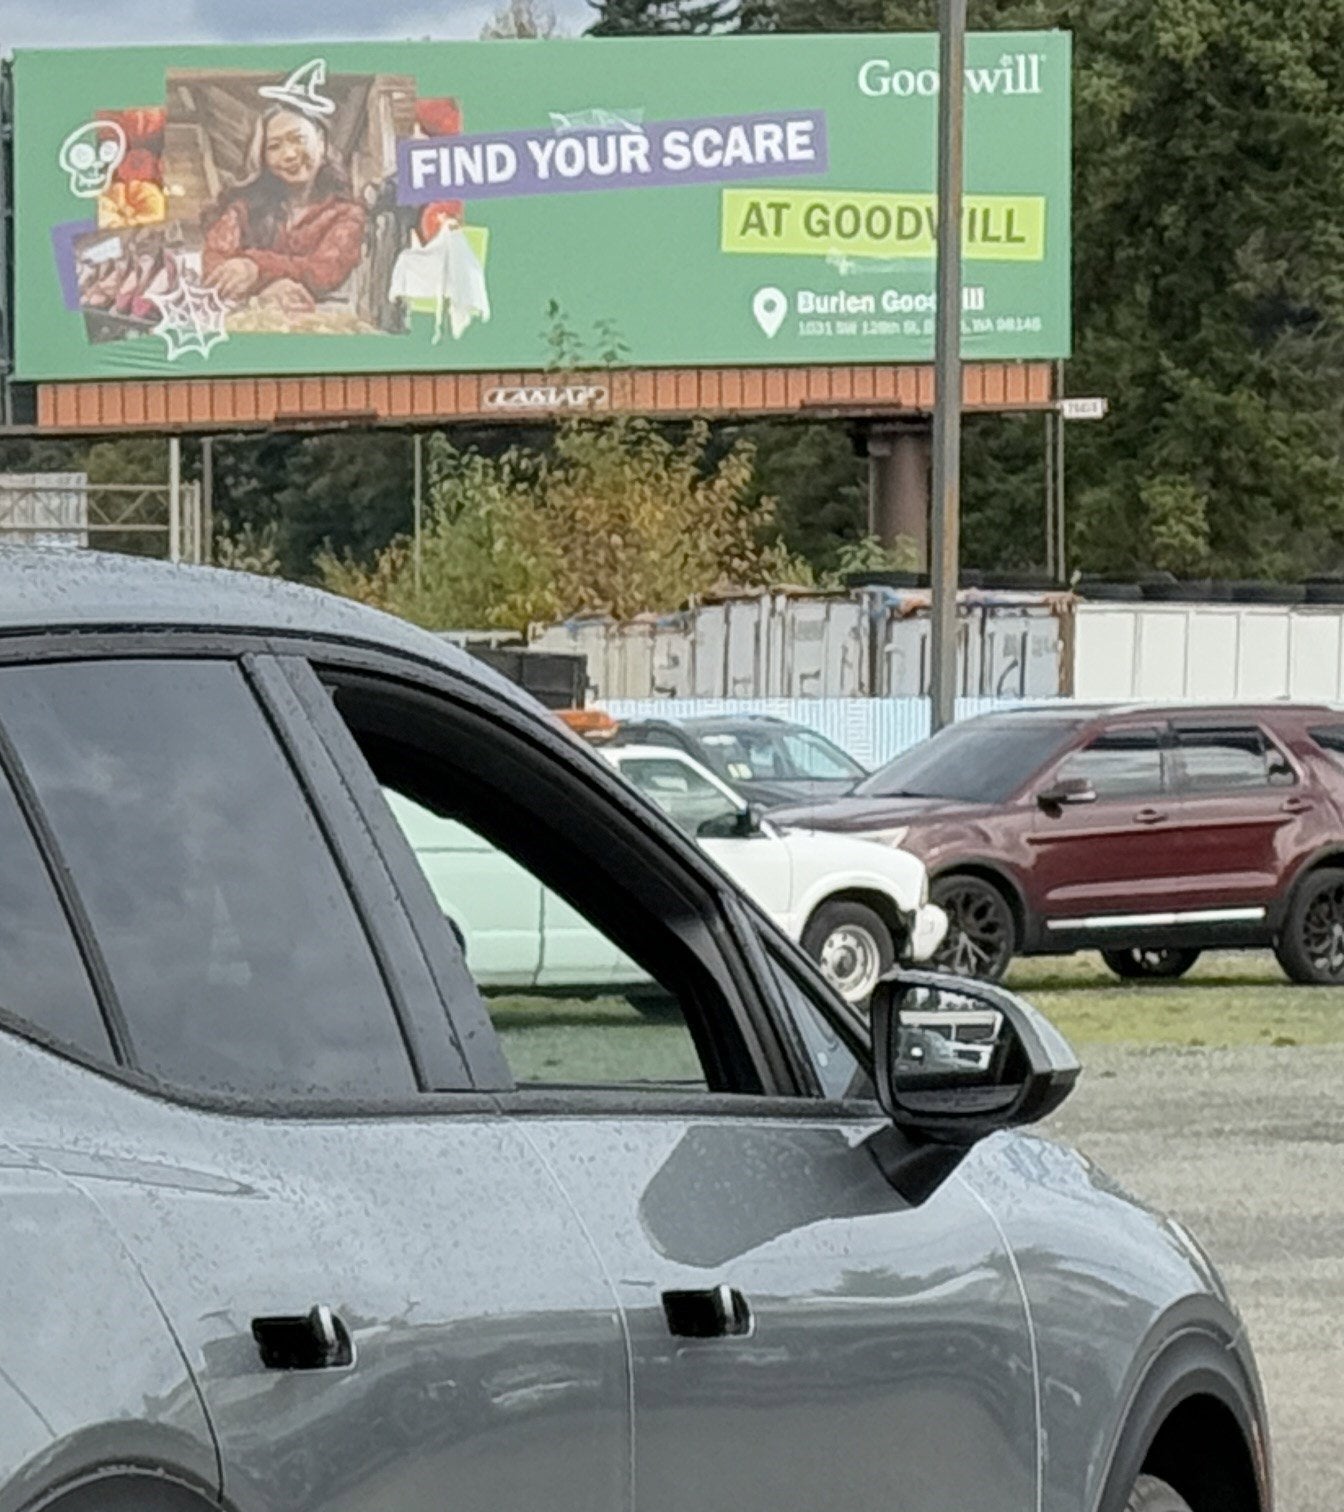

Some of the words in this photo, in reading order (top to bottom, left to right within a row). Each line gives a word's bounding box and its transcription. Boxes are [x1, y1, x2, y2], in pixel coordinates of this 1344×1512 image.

[858, 54, 1042, 97] Goowill
[411, 145, 516, 189] FIND
[527, 135, 652, 179] YOUR
[662, 120, 815, 170] SCARE
[740, 201, 791, 237] AT
[881, 287, 986, 313] Gooill
